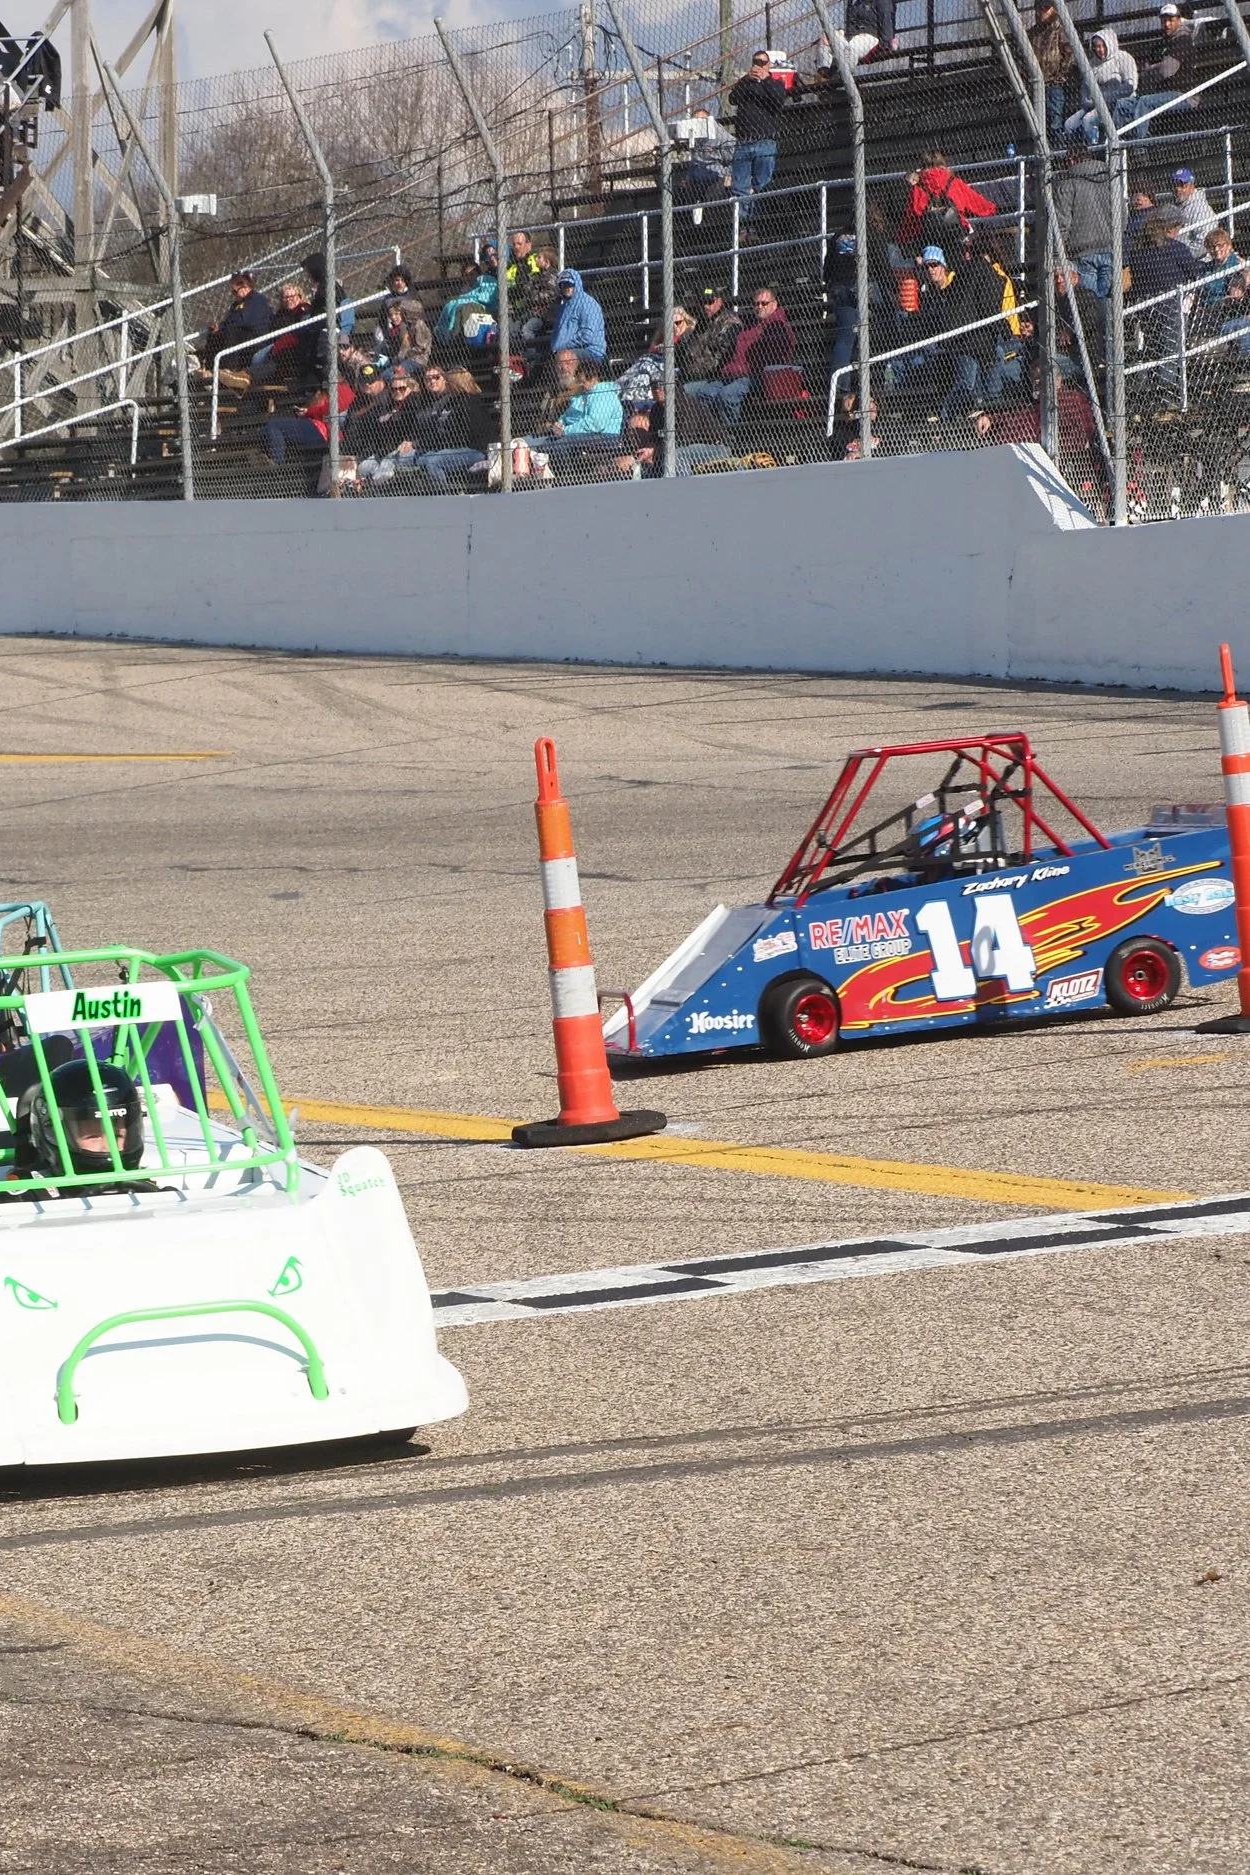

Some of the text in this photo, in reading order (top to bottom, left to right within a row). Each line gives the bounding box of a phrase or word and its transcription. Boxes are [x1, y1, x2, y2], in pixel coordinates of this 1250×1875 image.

[962, 866, 1071, 896] Zachary Kline
[809, 909, 910, 950] RE/MAX
[834, 939, 912, 965] ELITE GROUP
[914, 893, 1037, 999] 14
[1051, 973, 1099, 999] KLOTZ
[72, 990, 142, 1021] Austin
[688, 1010, 756, 1034] Hoosier
[94, 1108, 127, 1119] zmp
